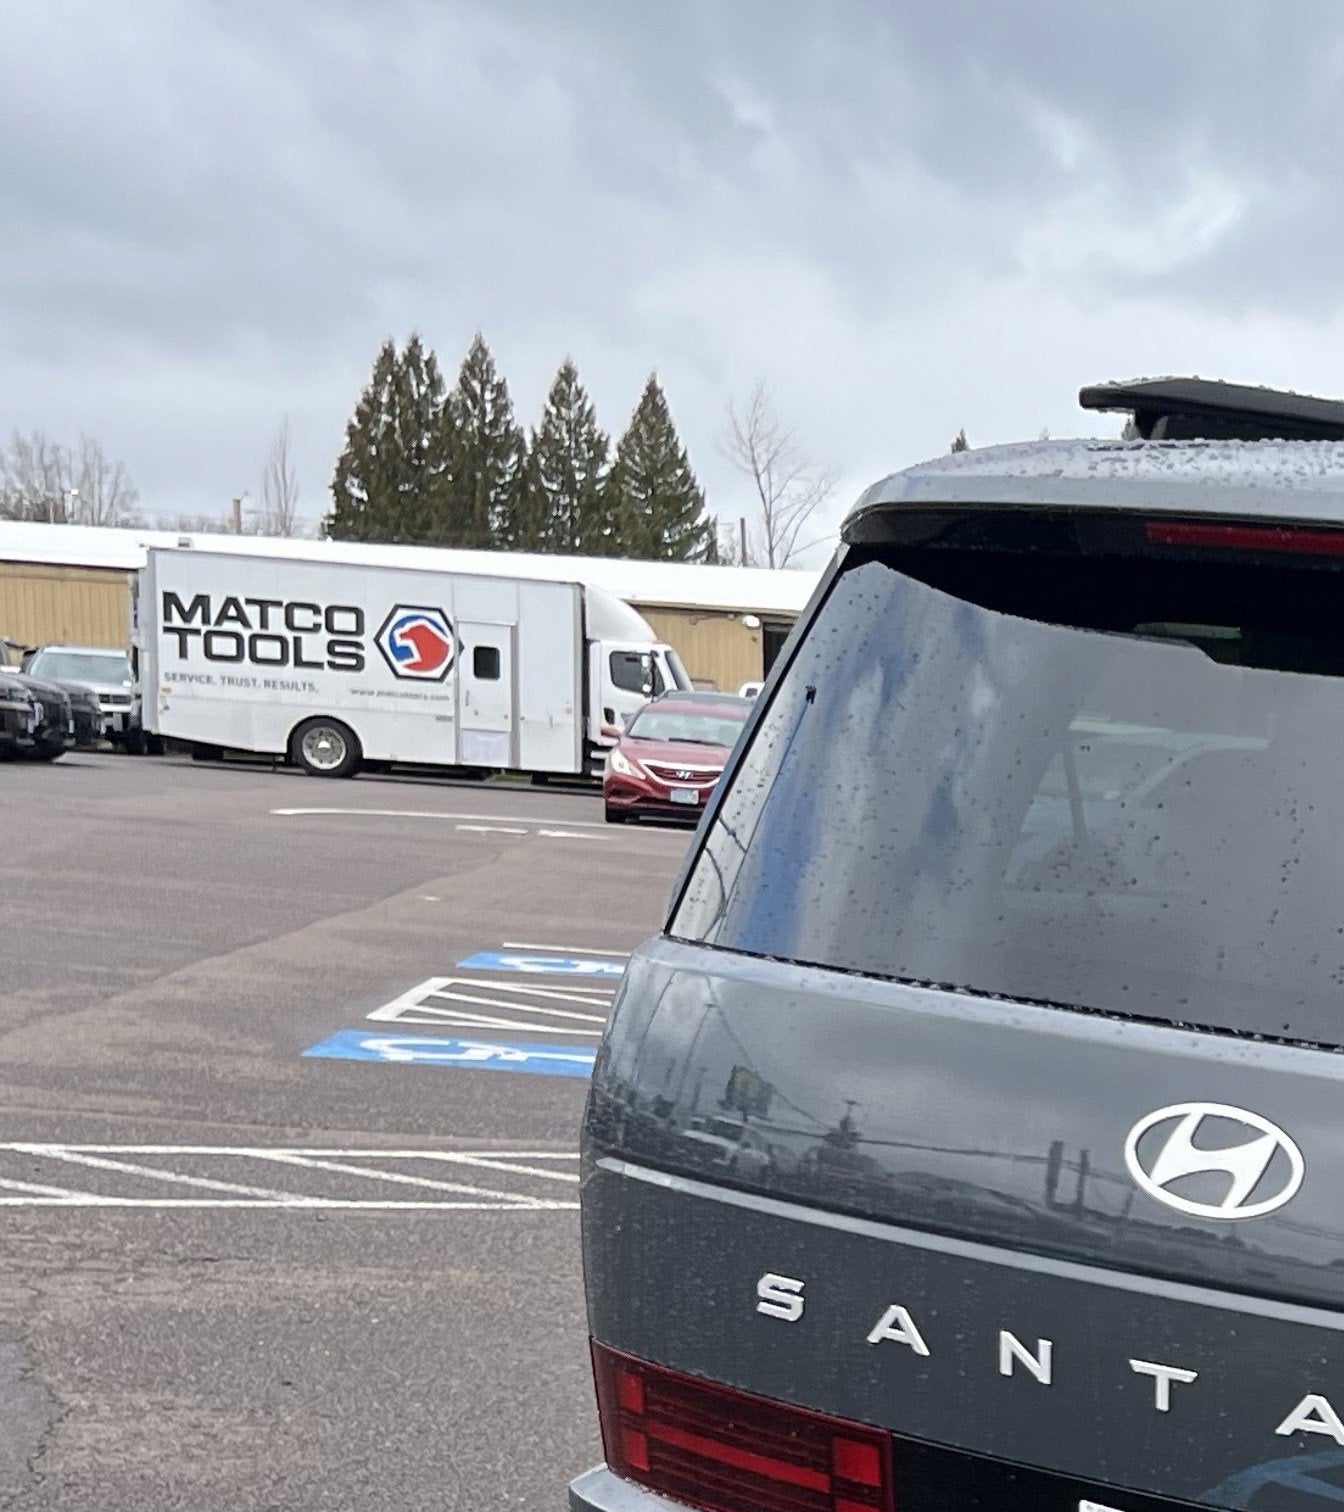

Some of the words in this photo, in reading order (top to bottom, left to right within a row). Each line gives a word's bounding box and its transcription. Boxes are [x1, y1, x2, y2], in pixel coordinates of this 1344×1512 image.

[162, 591, 366, 637] MATCO
[162, 625, 366, 673] TOOLS
[163, 672, 217, 686] SERVICE.
[220, 675, 261, 689] TRUST.
[264, 678, 320, 694] RESULTS.
